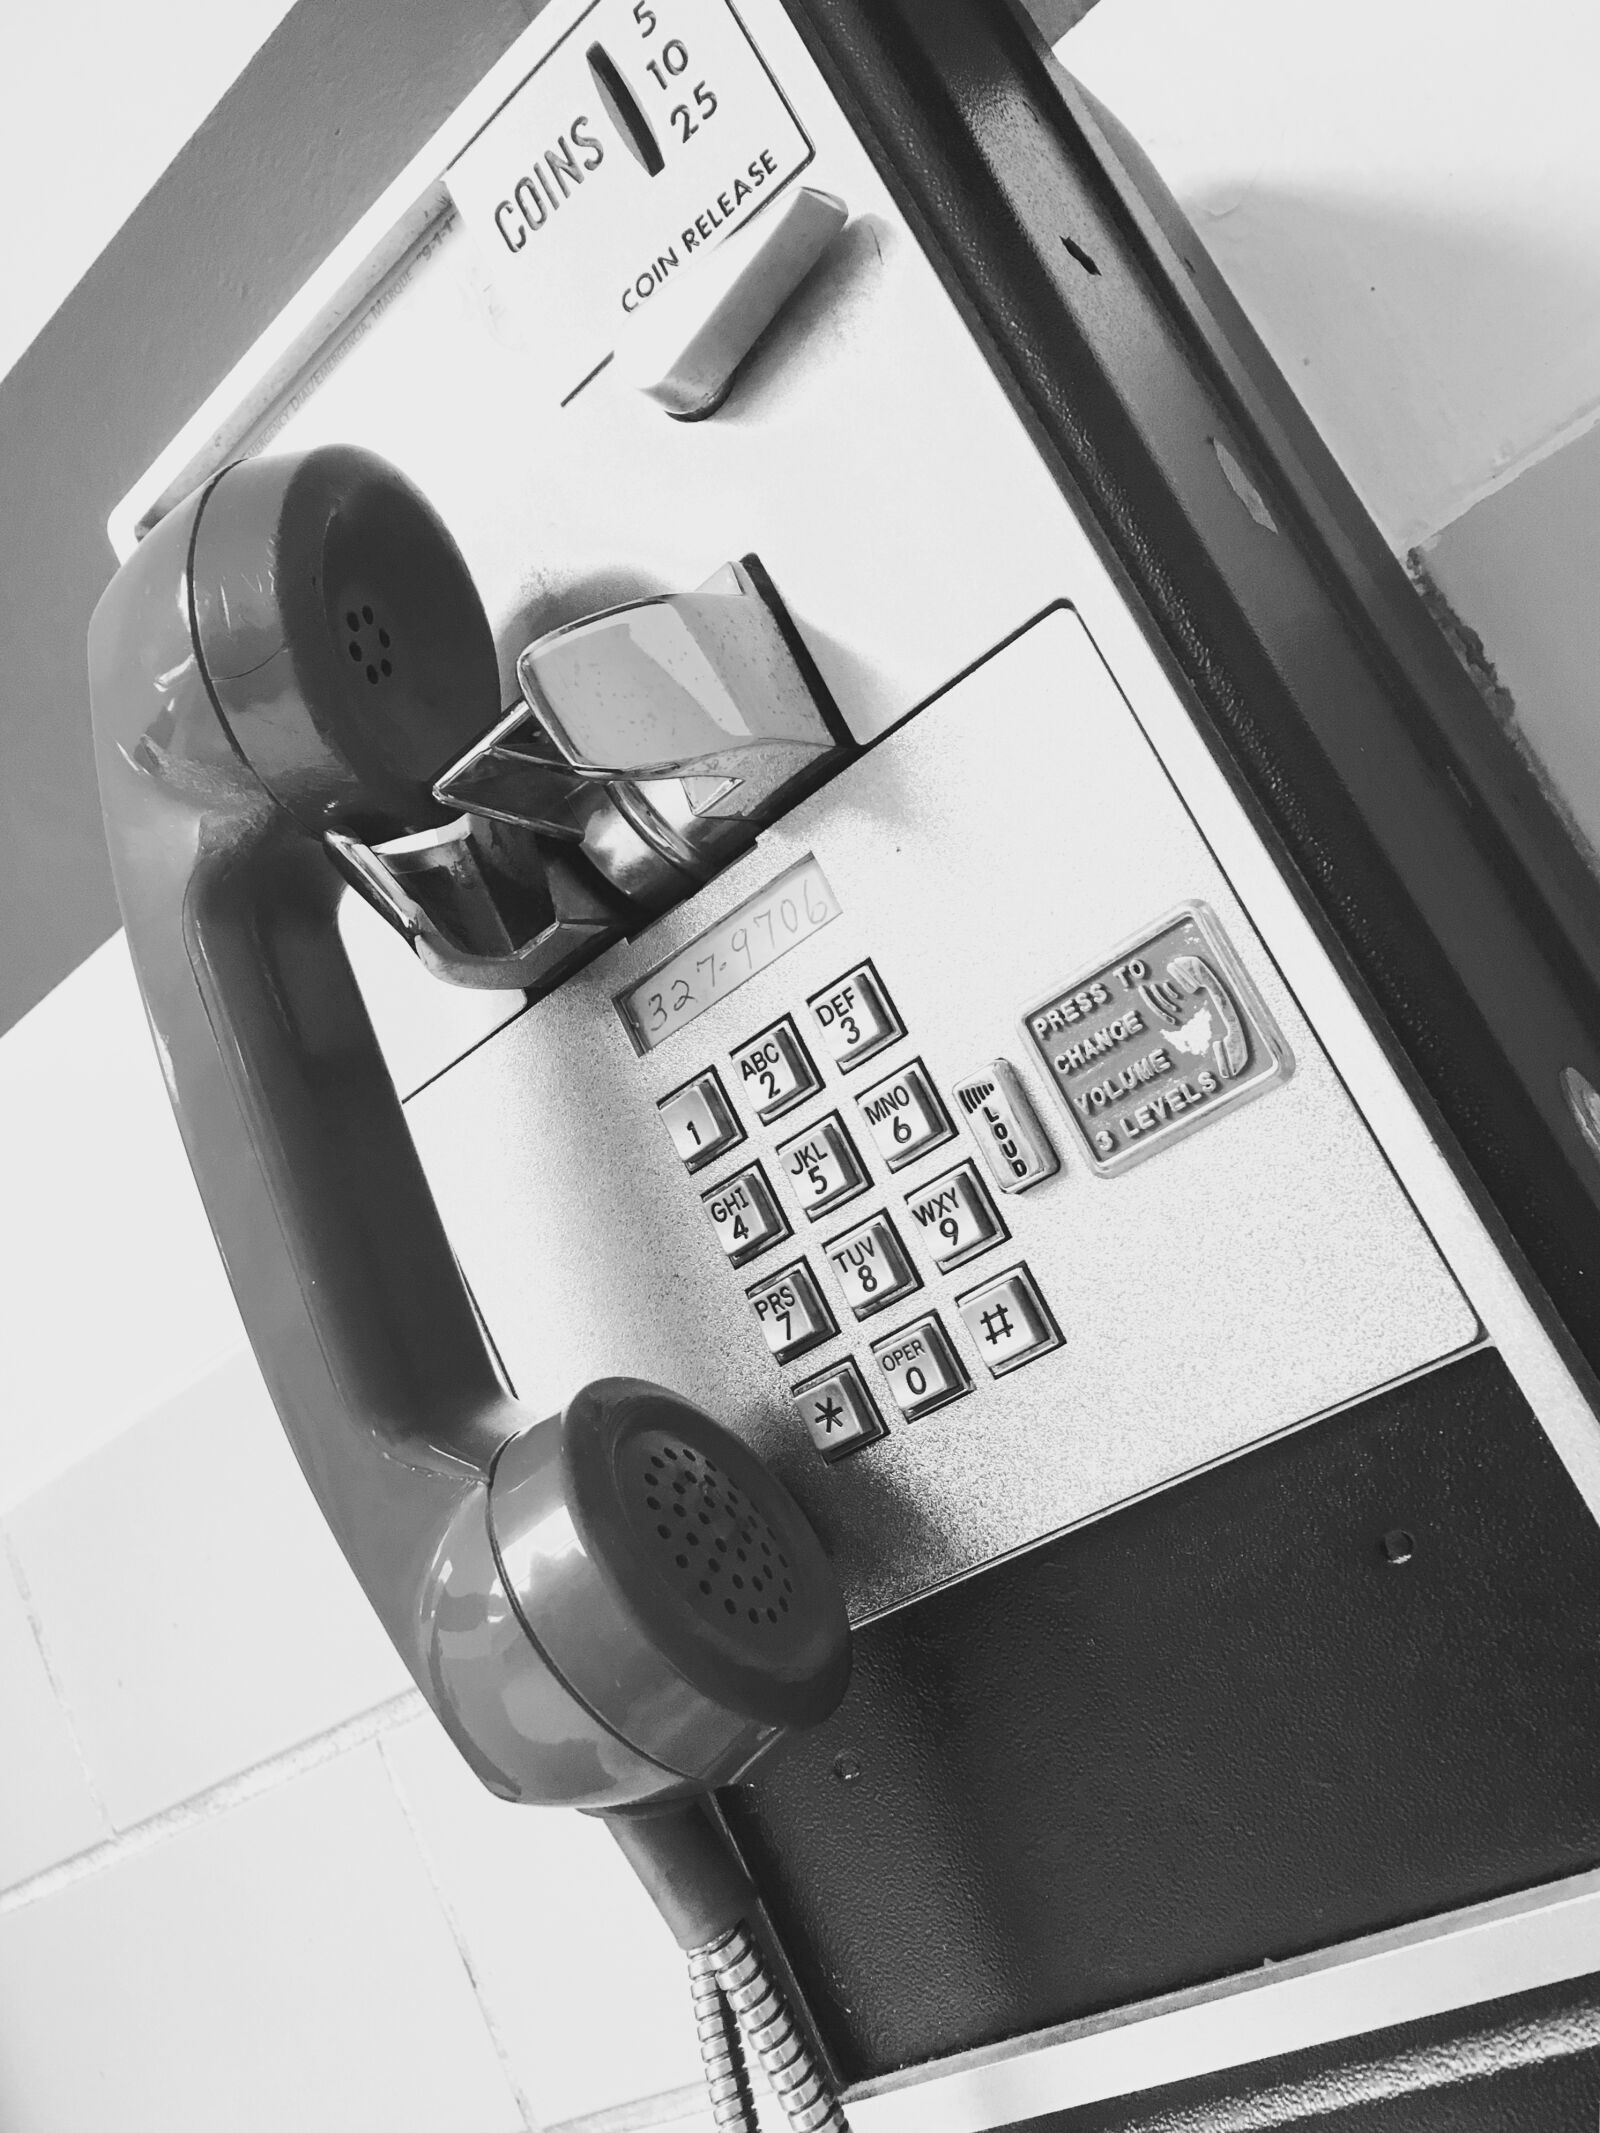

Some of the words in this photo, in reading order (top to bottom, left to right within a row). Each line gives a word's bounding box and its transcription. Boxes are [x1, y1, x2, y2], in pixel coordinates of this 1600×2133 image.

[633, 0, 657, 38] 5
[646, 39, 689, 90] 10
[670, 80, 718, 143] 25
[494, 116, 604, 253] COINS
[621, 246, 679, 313] COIN
[682, 149, 778, 253] RELEASE
[242, 406, 289, 459] MERGENCY
[816, 988, 855, 1027] DEF
[1032, 983, 1108, 1039] PRESS
[1113, 959, 1146, 988] TO
[840, 1016, 861, 1044] 3
[1054, 1010, 1144, 1075] CHANGE
[739, 1042, 780, 1081] ABC
[759, 1071, 781, 1099] 2
[1073, 1049, 1171, 1115] VOLUME
[864, 1085, 910, 1126] MNO
[1119, 1071, 1217, 1138] LEVELS
[686, 1121, 702, 1146] 1
[893, 1113, 912, 1143] 6
[983, 1106, 1028, 1177] LOUD
[790, 1141, 828, 1175] JKL
[808, 1167, 828, 1195] 5
[711, 1187, 750, 1223] GHI
[912, 1187, 960, 1227] WXY
[733, 1216, 750, 1239] 4
[939, 1218, 960, 1245] 9
[832, 1236, 875, 1273] TUV
[857, 1265, 878, 1292] 8
[754, 1286, 795, 1321] PRS
[775, 1312, 792, 1341] 7
[882, 1339, 925, 1372] OPER
